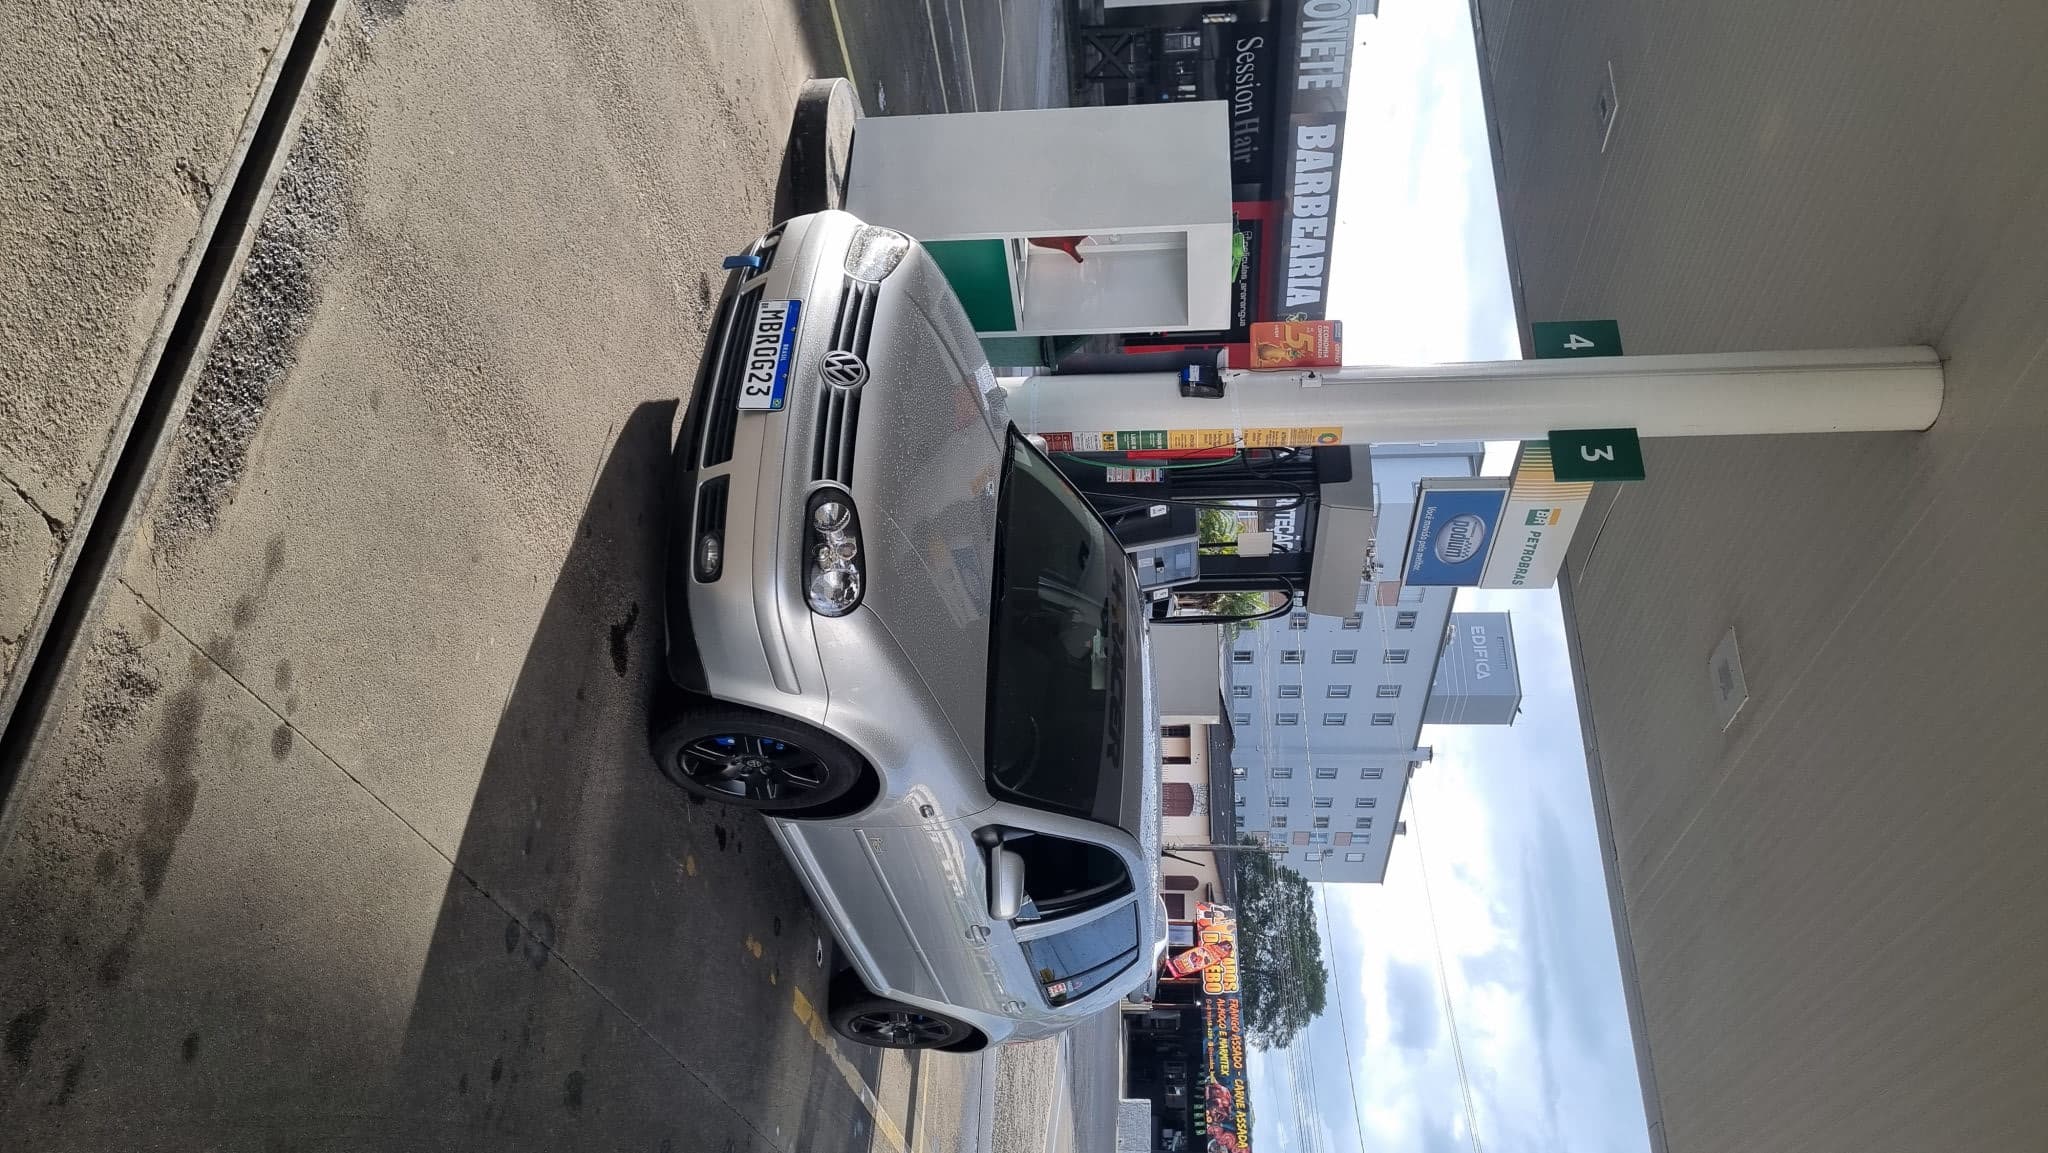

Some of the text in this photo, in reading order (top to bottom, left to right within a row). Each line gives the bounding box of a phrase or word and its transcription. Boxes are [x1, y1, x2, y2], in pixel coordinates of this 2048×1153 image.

[1232, 36, 1265, 163] Session Hair
[1286, 124, 1337, 306] BARBEARIA
[780, 344, 789, 361] BRASIL
[1564, 334, 1594, 350] 4
[1580, 445, 1614, 461] 3
[1420, 520, 1432, 540] movido
[1424, 506, 1438, 520] Você
[1417, 540, 1427, 552] pelo
[1444, 520, 1471, 558] podium
[1512, 530, 1542, 586] PETROBRAS
[1470, 626, 1490, 680] EDIFICA
[1216, 998, 1226, 1029] ALMOÇO
[1229, 998, 1240, 1032] FRANGO
[1218, 1038, 1229, 1076] MARMITEX
[1231, 1034, 1242, 1068] ASSADO
[1234, 1079, 1246, 1109] CARNE
[1236, 1110, 1248, 1148] ASSADA
